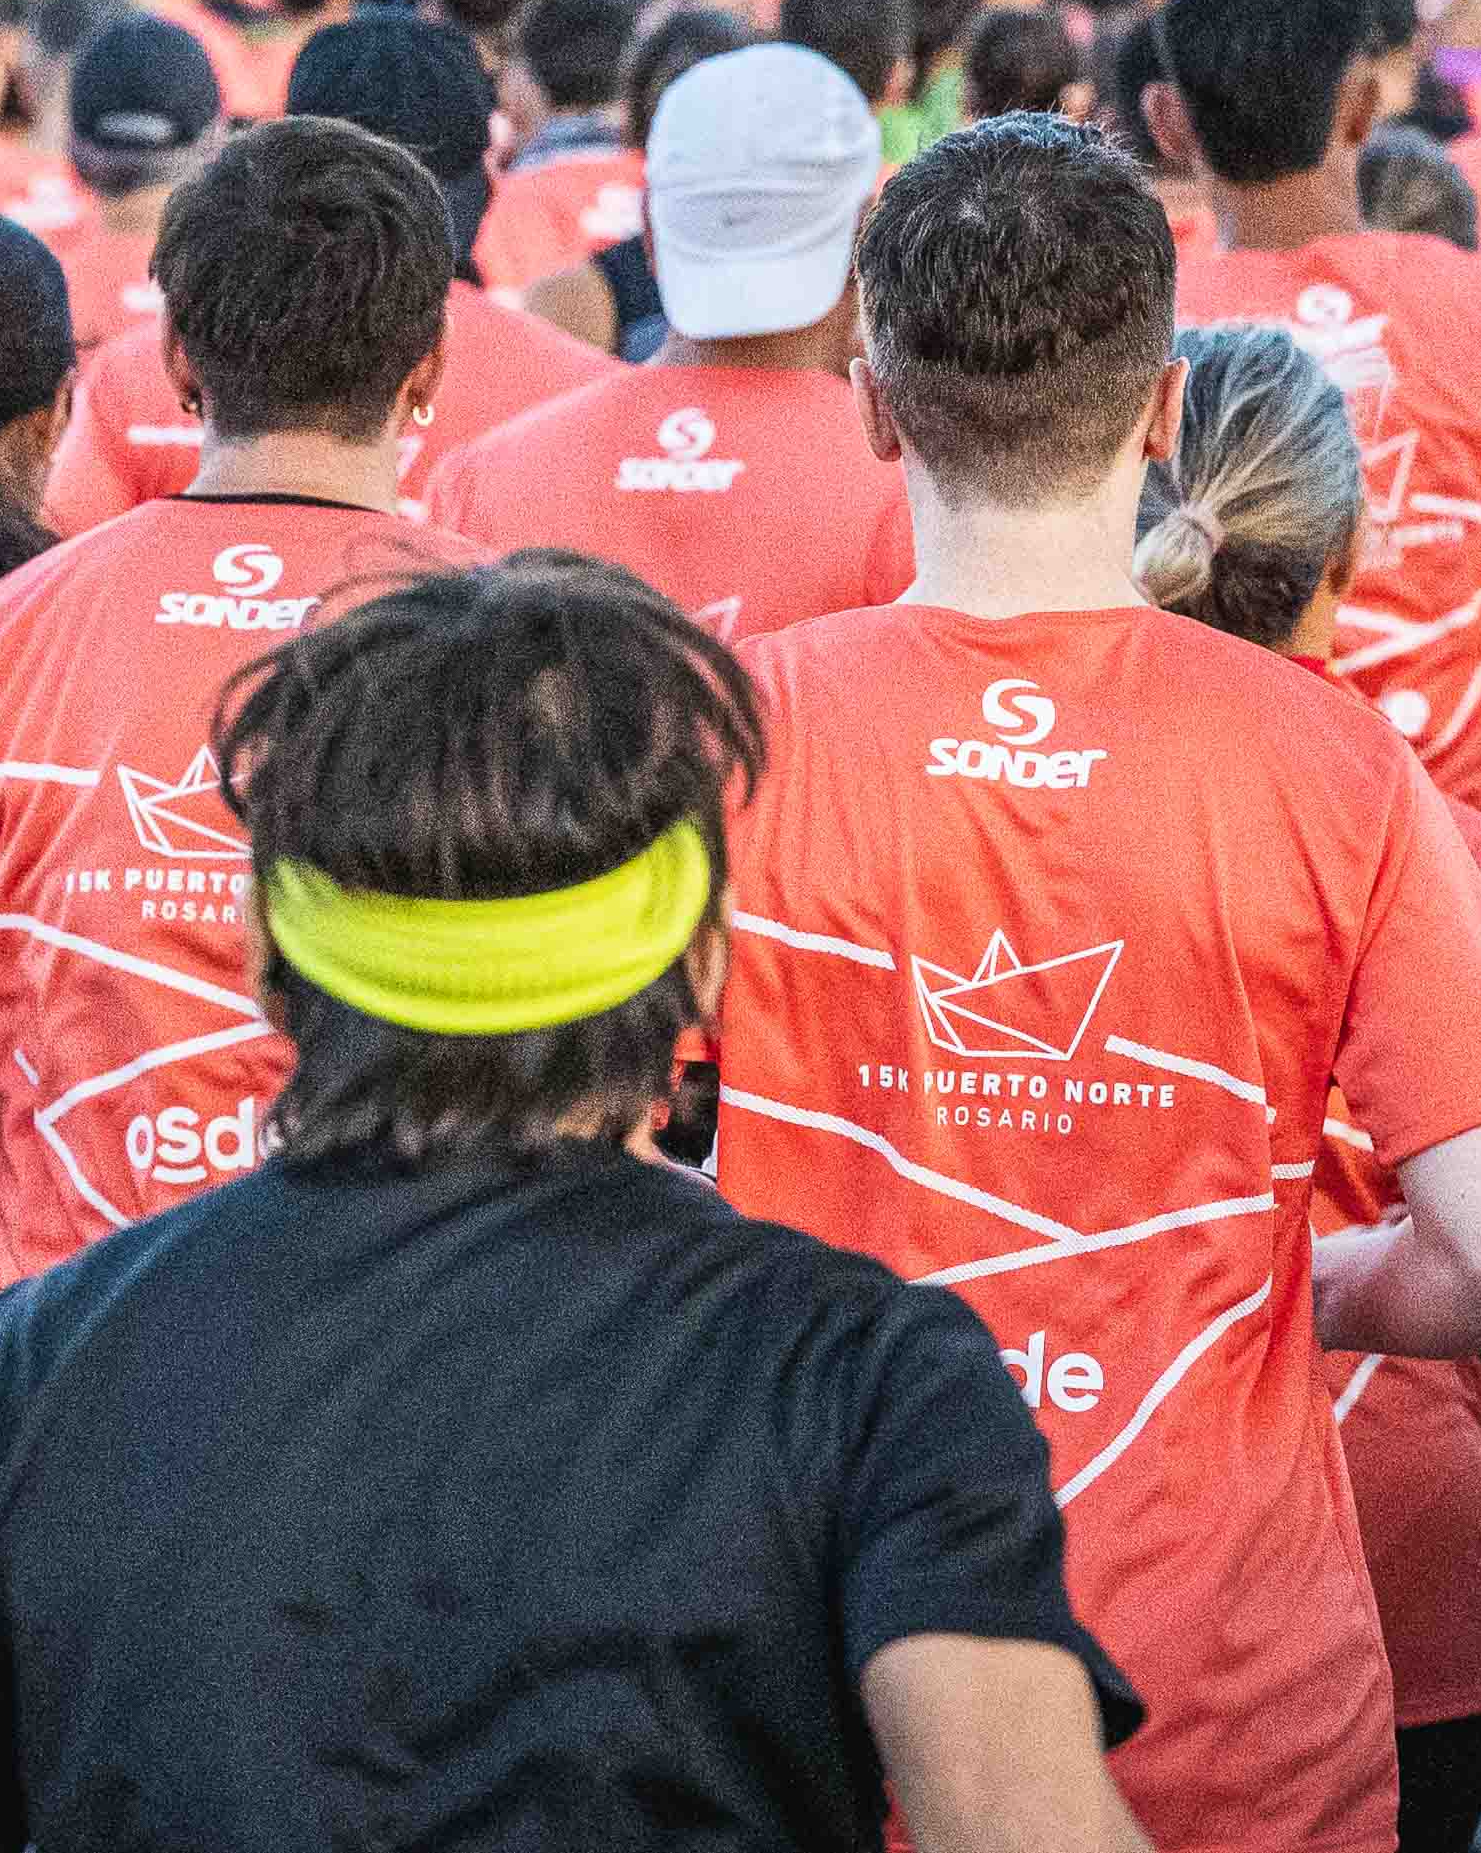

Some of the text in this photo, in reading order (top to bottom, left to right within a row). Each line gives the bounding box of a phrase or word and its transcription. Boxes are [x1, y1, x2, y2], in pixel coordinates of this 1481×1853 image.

[141, 899, 244, 924] ROSAR
[859, 1064, 909, 1093] 15K
[1064, 1078, 1175, 1108] NORTE
[125, 1096, 271, 1172] osd
[936, 1106, 1073, 1135] ROSARIO
